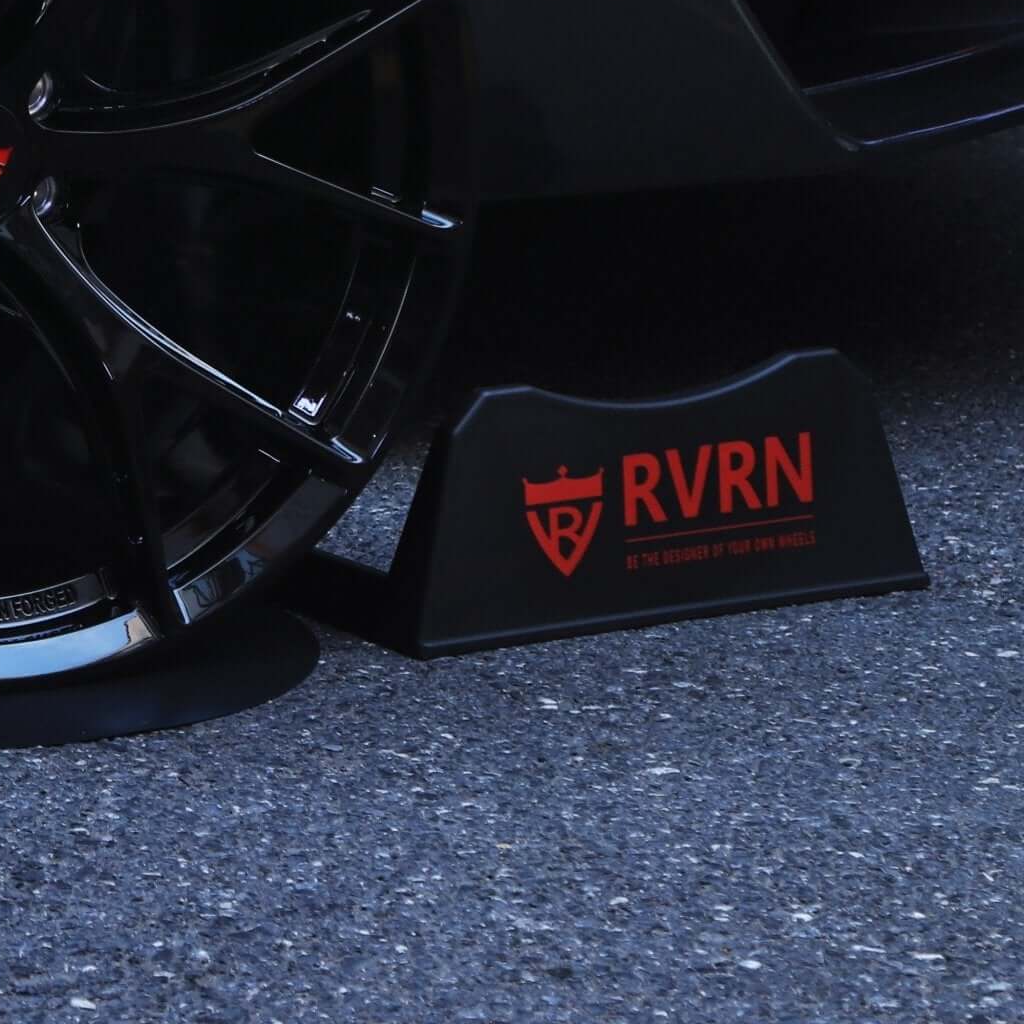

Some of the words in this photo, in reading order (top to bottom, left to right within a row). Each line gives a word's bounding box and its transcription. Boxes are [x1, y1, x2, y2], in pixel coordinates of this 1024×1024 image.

[621, 432, 814, 527] RVRN
[641, 551, 660, 567] THE
[663, 544, 710, 566] DESIGNER
[712, 542, 724, 559] OF
[727, 538, 751, 555] YOUR
[753, 536, 775, 553] OWN
[778, 530, 816, 549] WHEELS
